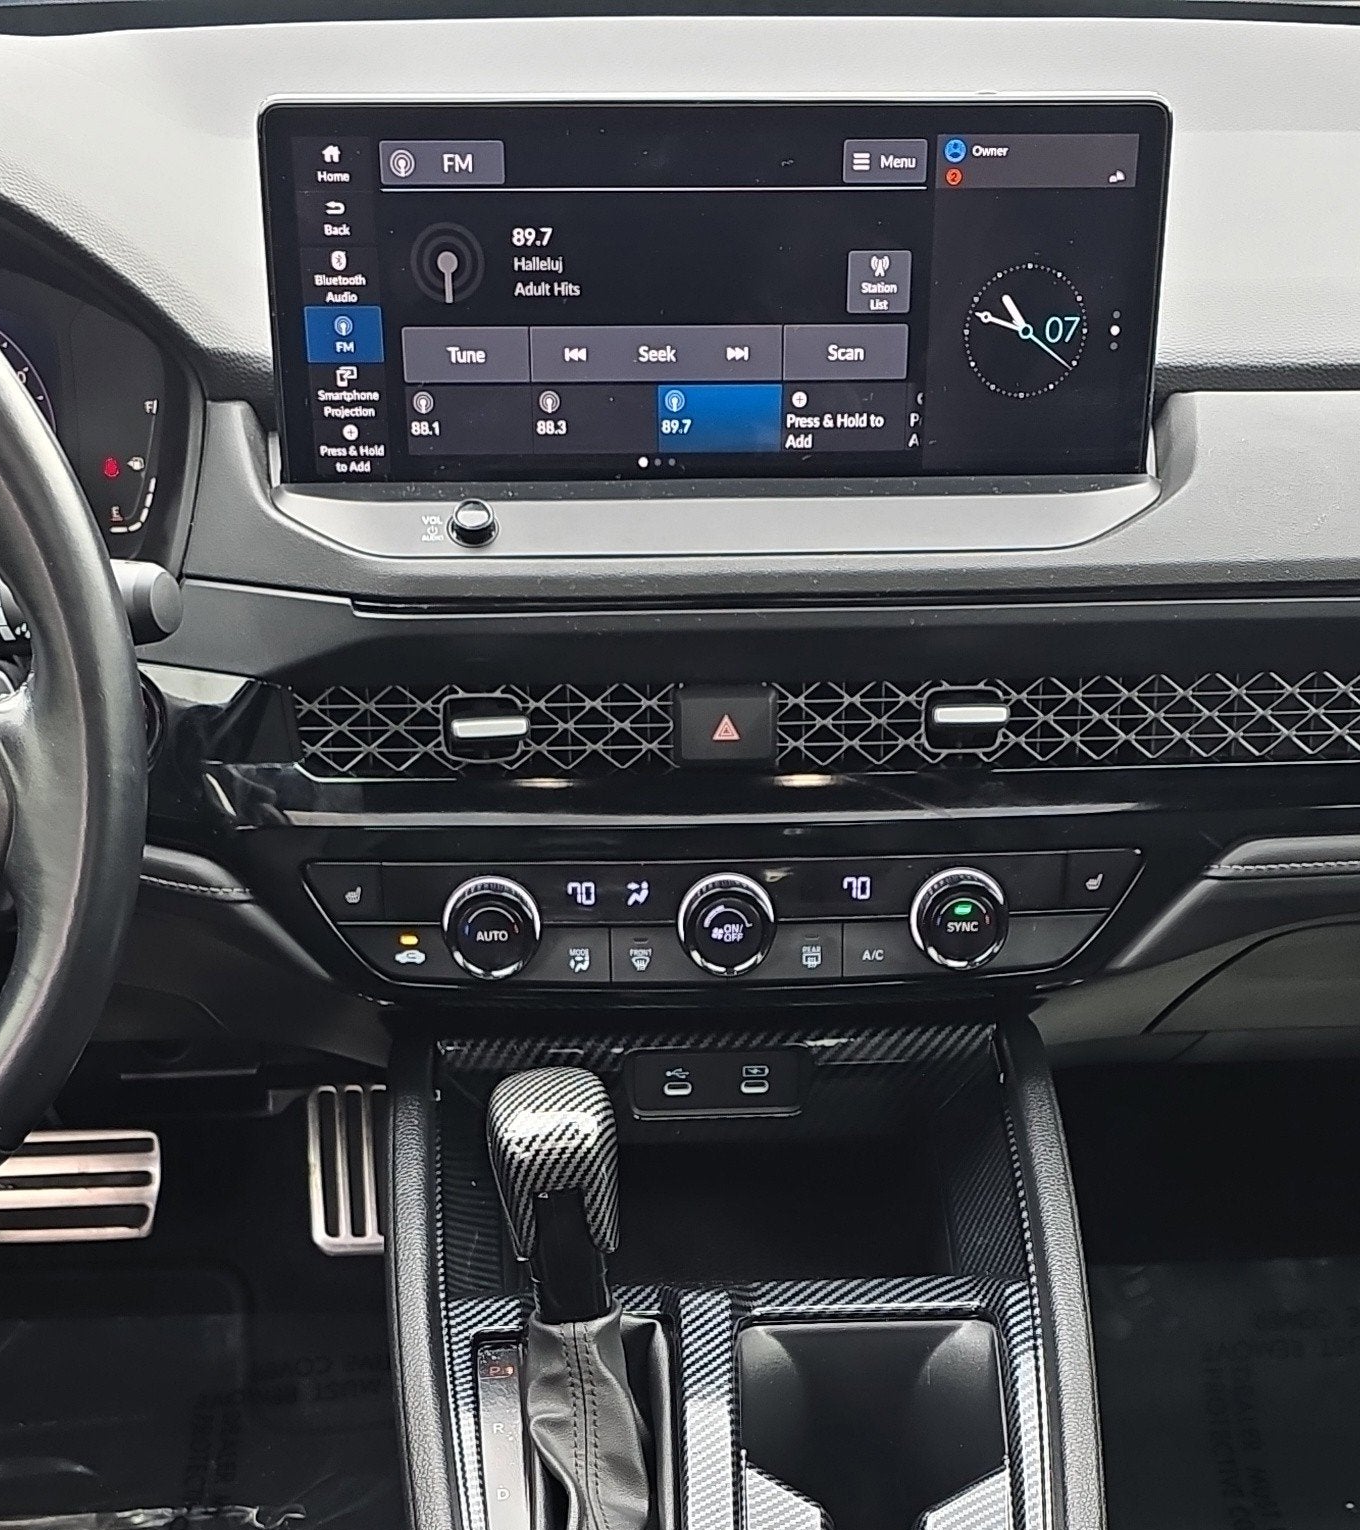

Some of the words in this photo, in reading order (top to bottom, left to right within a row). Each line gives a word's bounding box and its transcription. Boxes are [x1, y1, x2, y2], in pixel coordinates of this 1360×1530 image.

[972, 145, 1009, 157] Owner
[442, 153, 473, 173] FM
[880, 155, 916, 169] Menu
[317, 171, 350, 183] Home
[323, 224, 351, 236] Back
[512, 227, 552, 247] 89.7
[513, 256, 564, 274] Halleluj
[314, 275, 366, 287] Bluetooth
[514, 281, 551, 297] Adult
[554, 281, 581, 297] Hits
[860, 282, 897, 294] Station
[326, 291, 358, 303] Audio
[870, 300, 888, 311] List
[1045, 316, 1081, 343] 07
[335, 342, 355, 354] FM
[638, 345, 677, 363] Seek
[827, 344, 865, 362] Scan
[447, 346, 486, 364] Tune
[317, 390, 380, 403] Smartphone
[323, 406, 375, 418] Projection
[536, 420, 567, 435] 88.3
[661, 419, 691, 435] 89.7
[786, 414, 820, 429] Press
[822, 414, 834, 429] &
[836, 414, 867, 429] Hold
[870, 414, 885, 429] to
[411, 421, 440, 436] 88.1
[785, 434, 813, 449] Add
[320, 446, 346, 457] Press
[348, 446, 358, 457] &
[359, 446, 385, 457] Hold
[336, 462, 347, 473] to
[349, 462, 371, 473] Add
[422, 515, 443, 525] VOL
[567, 881, 596, 906] 70
[843, 876, 871, 900] 70
[724, 924, 744, 934] ON/
[947, 921, 978, 933] SYNC
[476, 929, 508, 942] AUTO
[724, 933, 743, 943] OFF
[570, 948, 589, 956] MODE
[630, 948, 652, 957] FRONT
[862, 949, 884, 961] A/C
[493, 1422, 504, 1434] R
[497, 1488, 510, 1500] D
